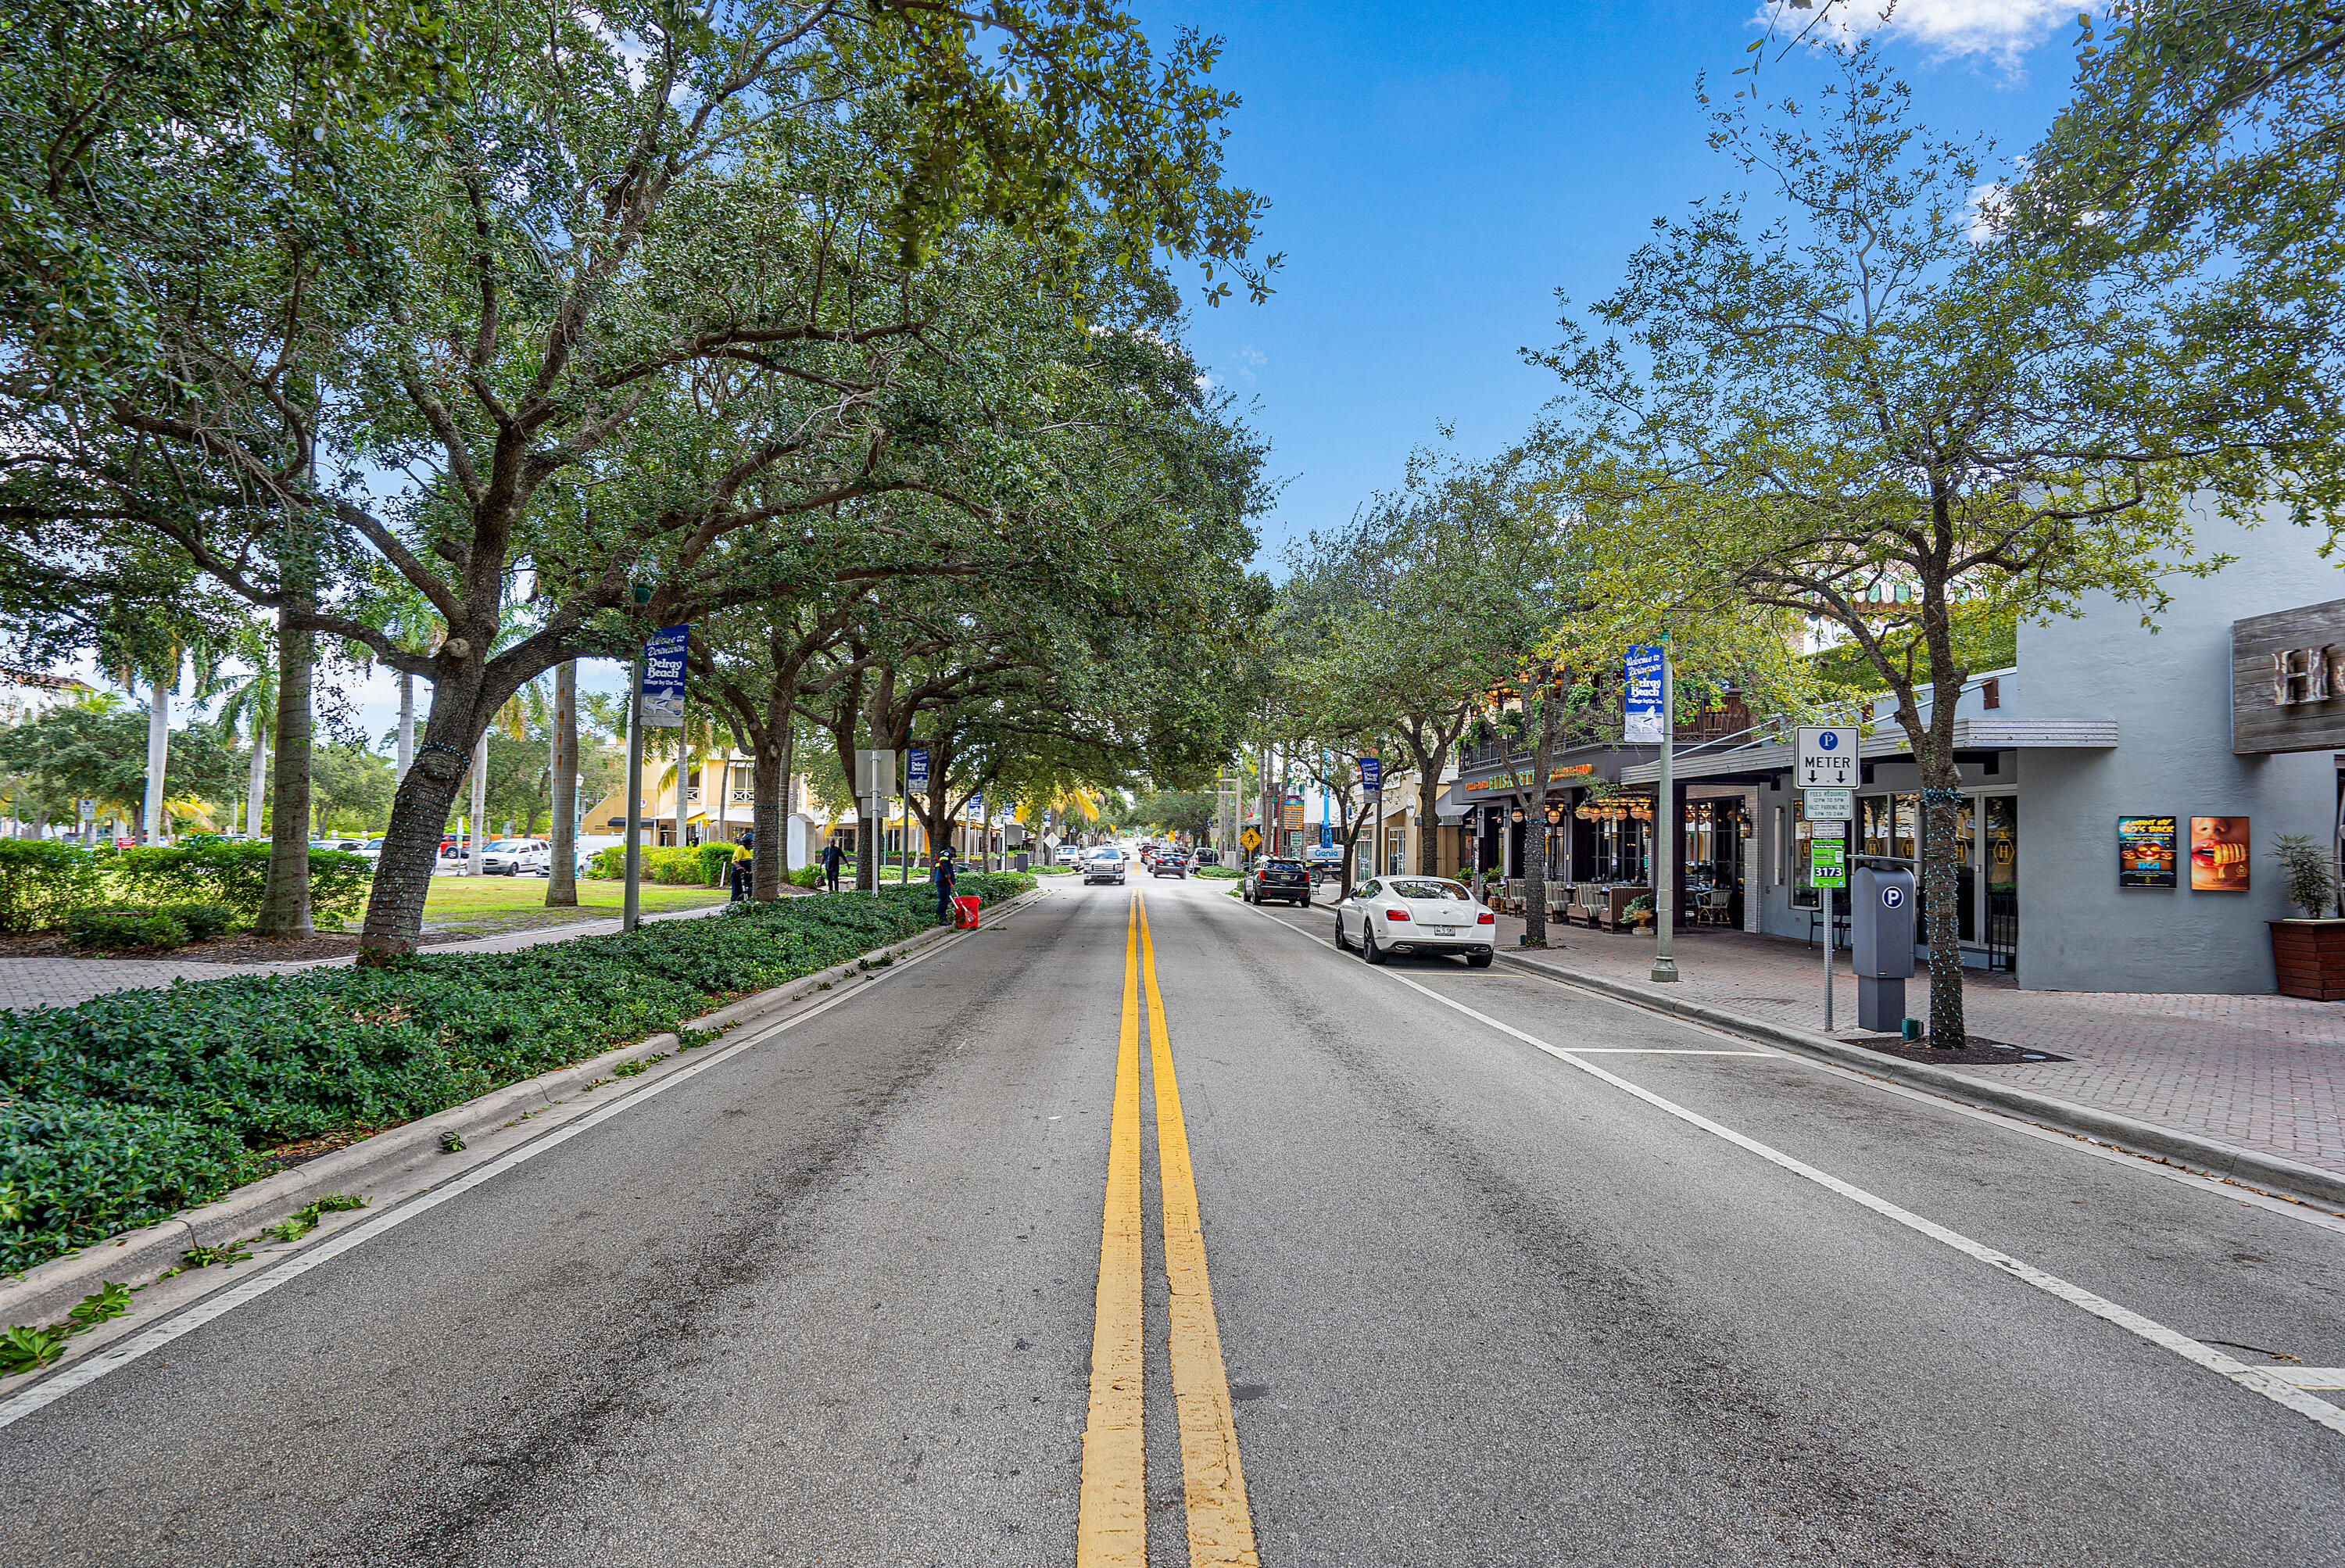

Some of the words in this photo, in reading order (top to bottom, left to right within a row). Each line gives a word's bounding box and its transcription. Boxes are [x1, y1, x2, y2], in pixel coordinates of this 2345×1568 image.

[647, 645, 686, 657] Downtown
[648, 657, 682, 670] Delray
[1626, 656, 1652, 666] Welcome
[646, 667, 679, 678] Beach
[1627, 664, 1662, 676] Downtown
[1631, 686, 1659, 697] Beach
[1805, 756, 1851, 768] METER
[1803, 843, 1810, 854] H
[1870, 844, 1876, 854] H
[1906, 845, 1914, 855] H
[1999, 845, 2009, 858] H
[2136, 861, 2161, 870] TKA
[1815, 867, 1843, 877] 3173
[1887, 890, 1899, 905] P
